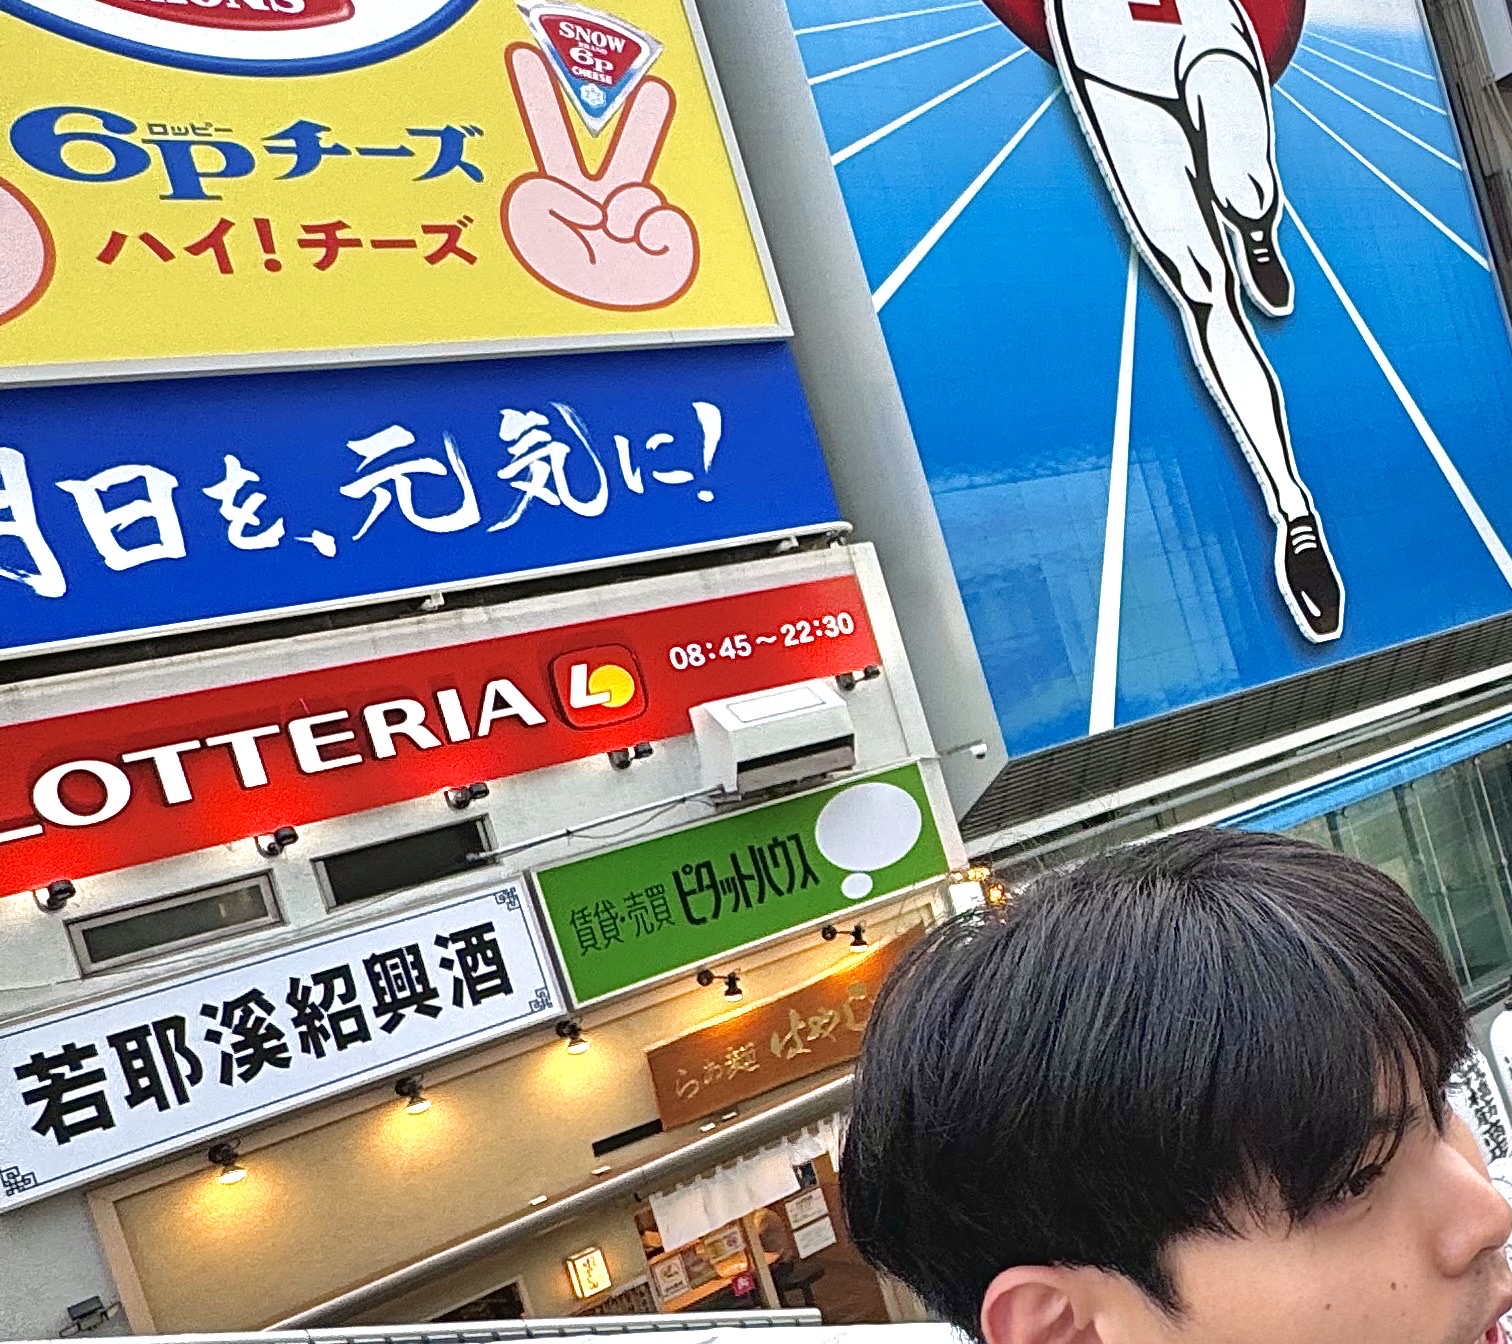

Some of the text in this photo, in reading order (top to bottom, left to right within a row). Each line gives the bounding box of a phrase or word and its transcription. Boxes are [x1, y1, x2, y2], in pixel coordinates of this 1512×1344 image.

[559, 21, 627, 54] SNOW
[571, 65, 613, 85] CHEESE
[147, 121, 233, 138] ロッピー
[0, 677, 544, 845] OTTERIA
[672, 832, 821, 926] ピタットハウス
